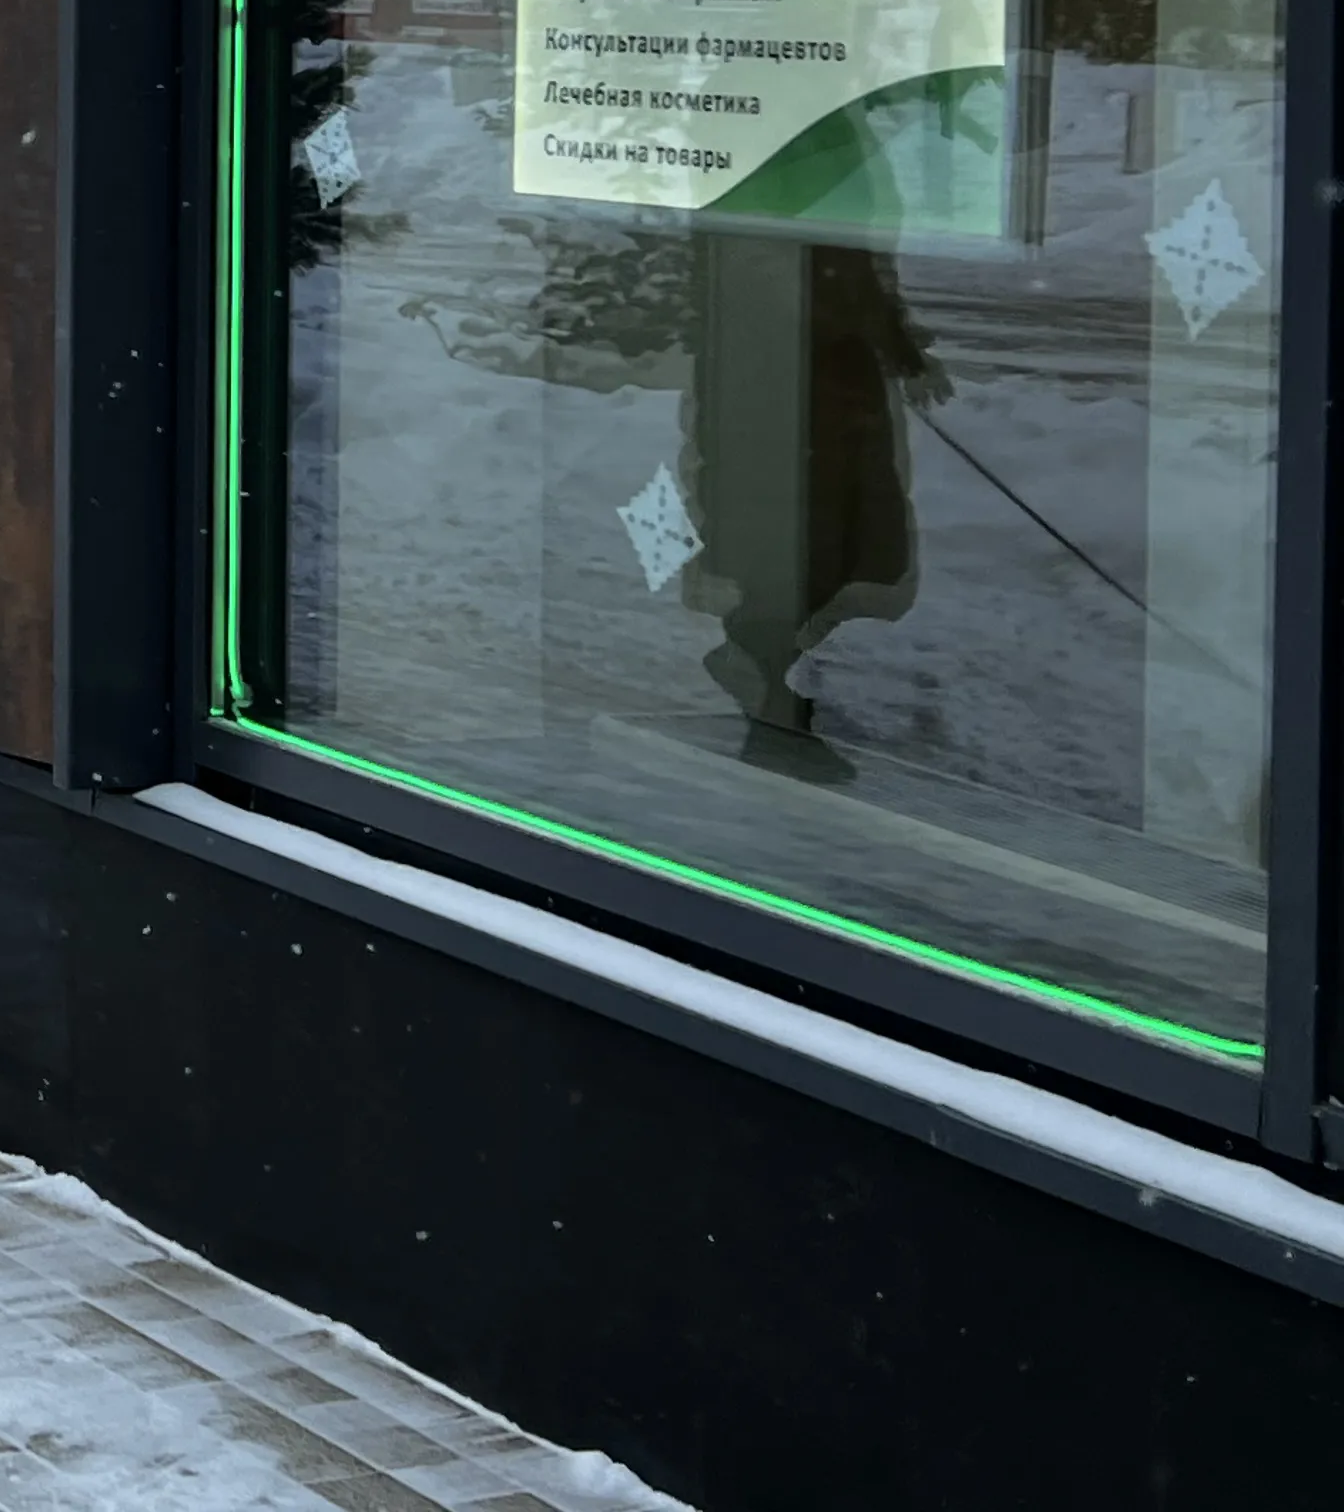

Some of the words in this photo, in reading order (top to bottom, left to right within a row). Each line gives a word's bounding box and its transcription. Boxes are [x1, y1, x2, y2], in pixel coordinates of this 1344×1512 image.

[544, 27, 689, 59] Консультации
[696, 32, 846, 63] фармацевтов
[543, 80, 643, 107] Лечебная
[650, 90, 761, 115] косметика
[543, 134, 618, 163] Скидки
[625, 143, 649, 163] на
[656, 145, 732, 173] товары
